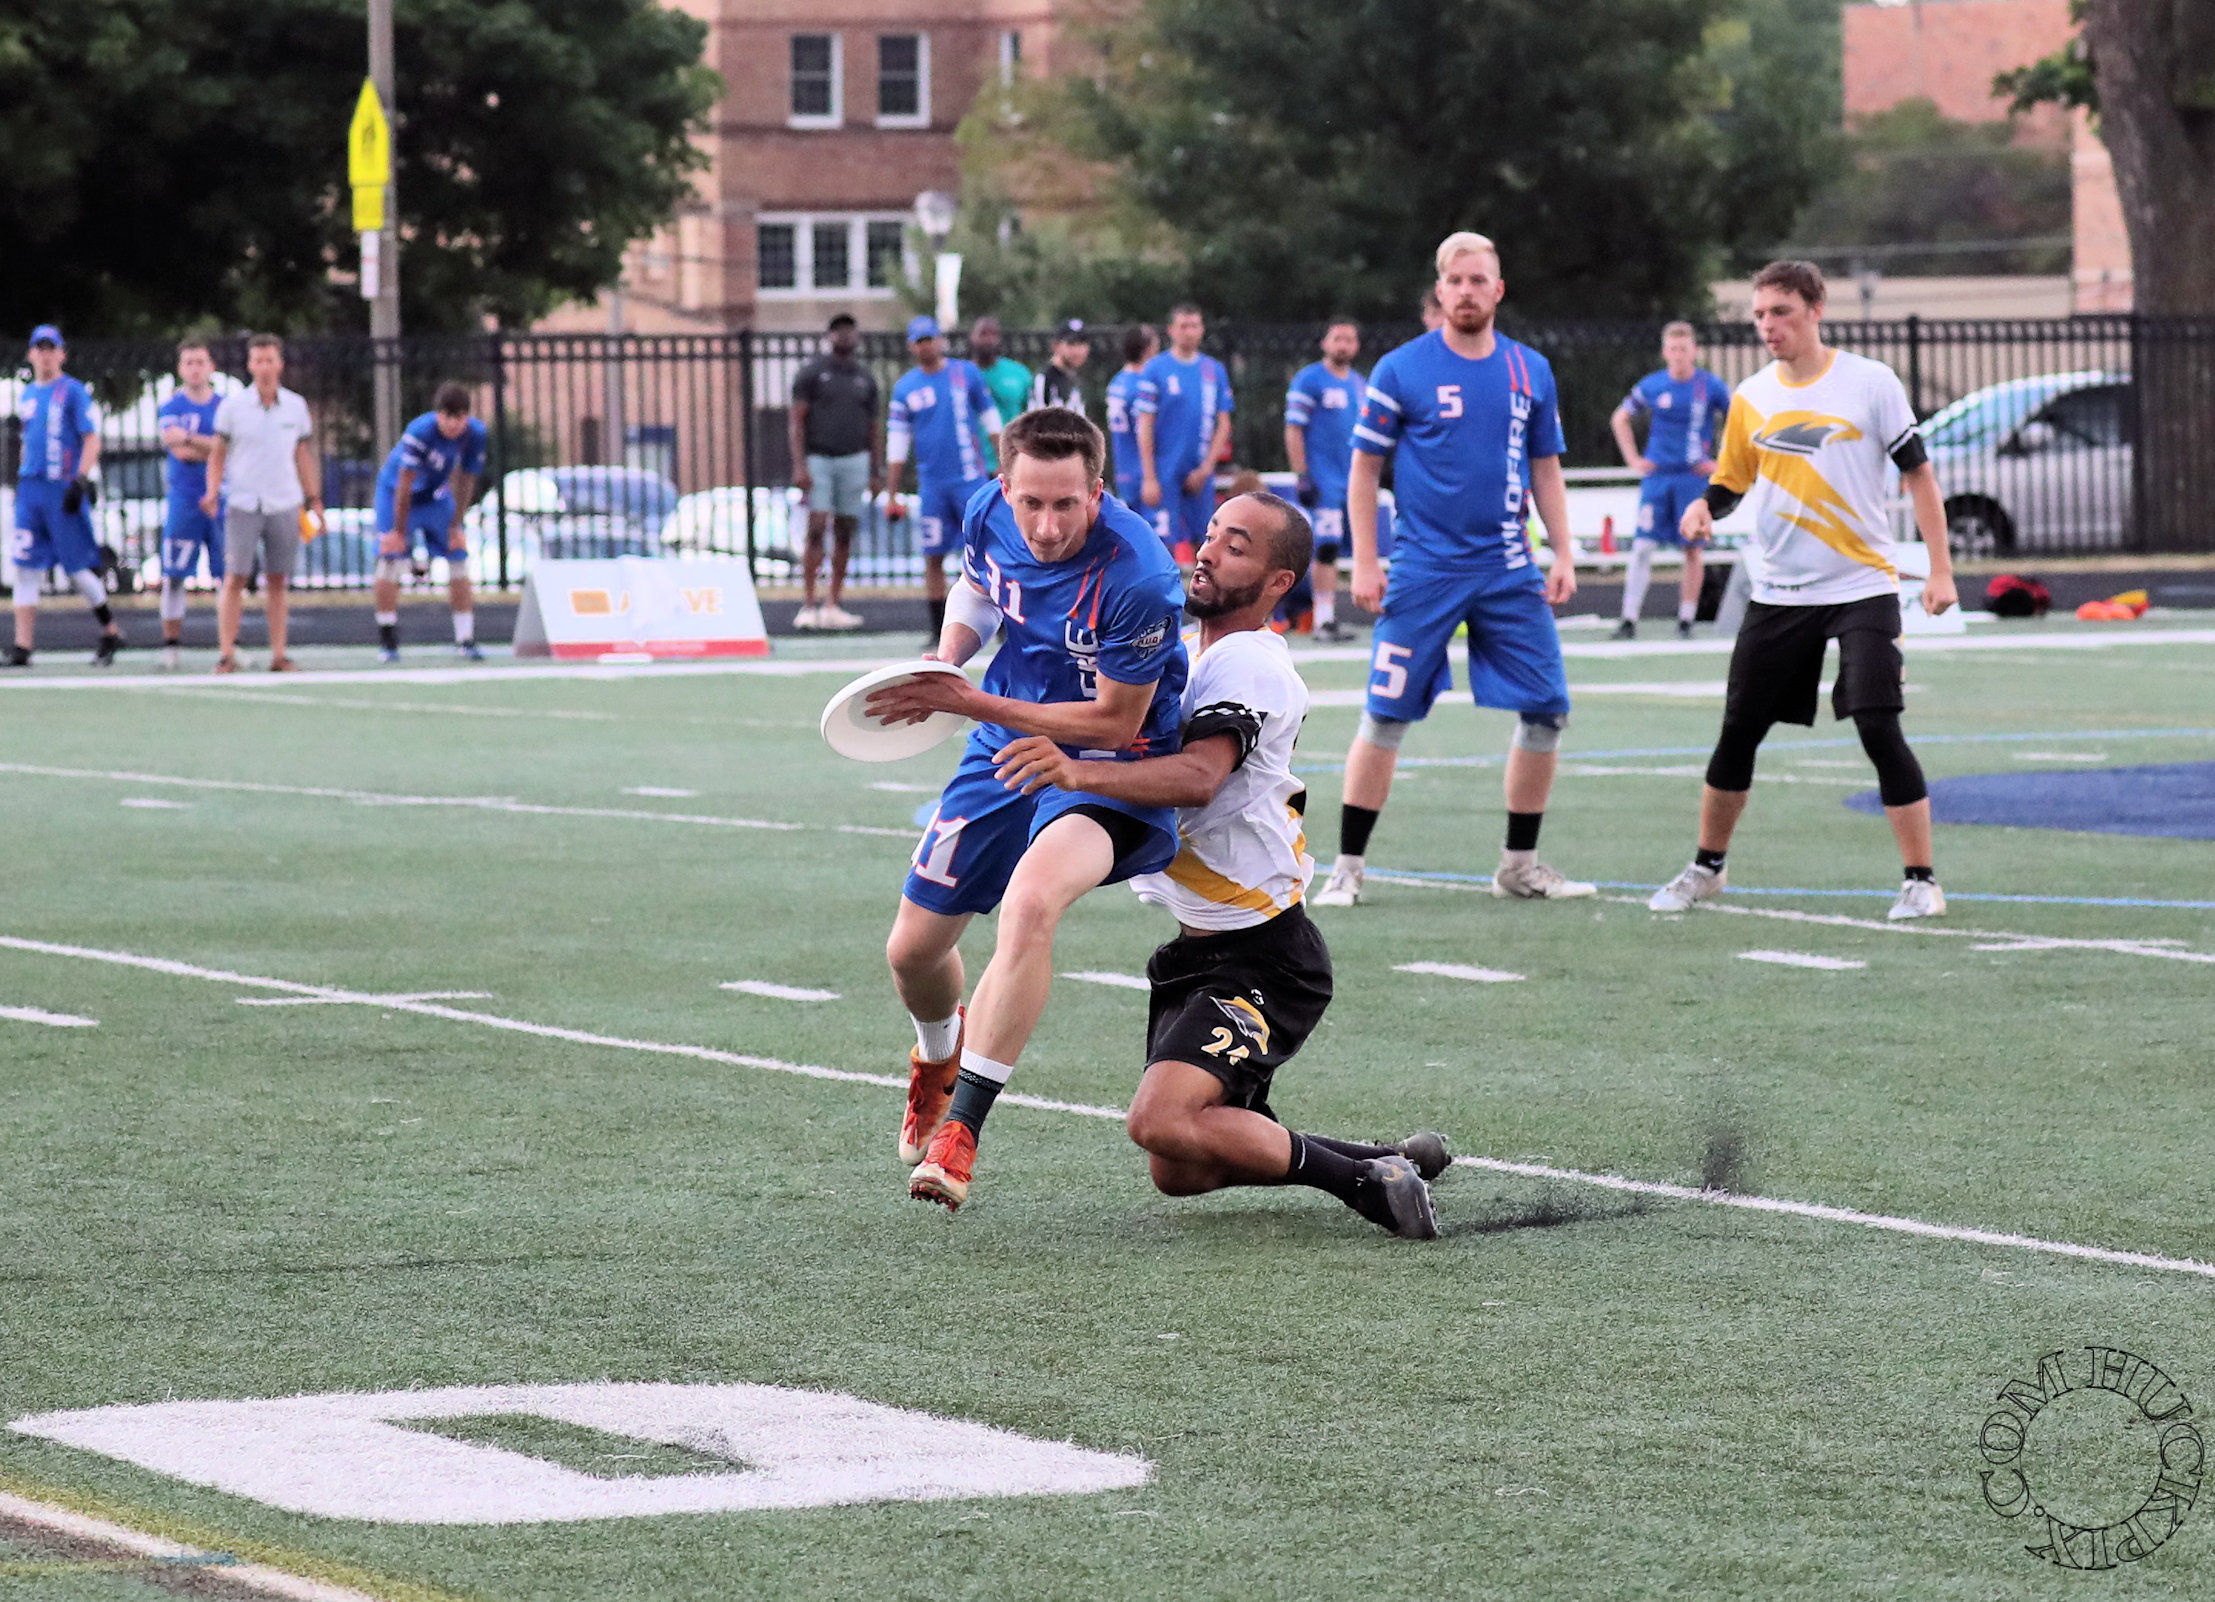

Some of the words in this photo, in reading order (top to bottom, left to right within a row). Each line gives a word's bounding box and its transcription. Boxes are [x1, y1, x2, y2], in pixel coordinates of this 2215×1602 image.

[1436, 384, 1464, 419] 5
[162, 536, 196, 570] 17
[1370, 641, 1413, 699] 5
